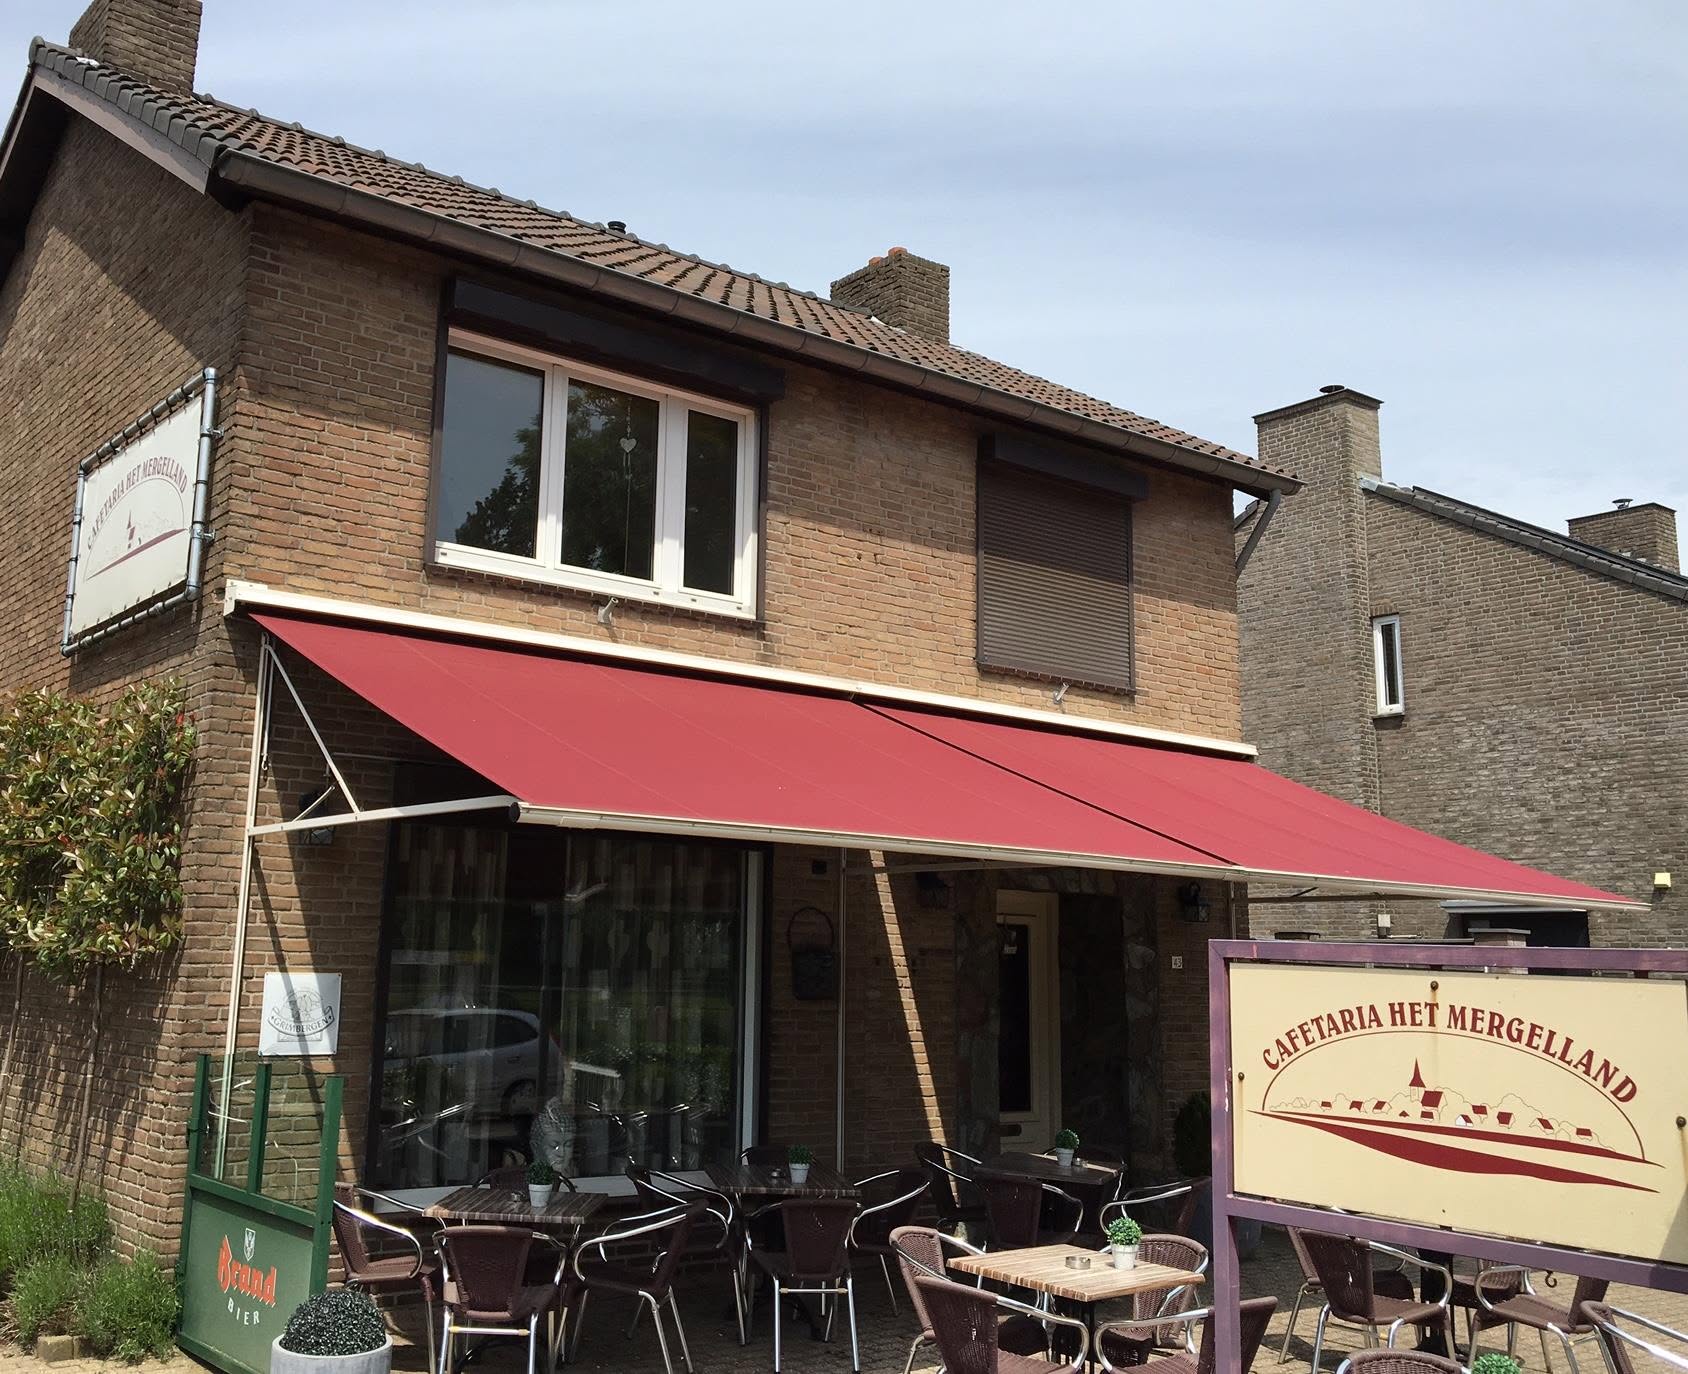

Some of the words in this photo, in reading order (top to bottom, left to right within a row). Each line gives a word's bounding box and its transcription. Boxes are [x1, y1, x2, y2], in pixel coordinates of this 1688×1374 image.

[87, 480, 125, 550] CAFETARIA
[126, 464, 141, 490] HET
[142, 456, 188, 494] MERGELLAND
[273, 1016, 329, 1033] GRIMBERGEN
[1262, 1004, 1384, 1071] CAFETARIA
[1388, 1001, 1440, 1028] HET
[1446, 1004, 1639, 1104] MERGELLAND
[217, 1234, 277, 1308] Brand
[227, 1297, 260, 1326] BIER
